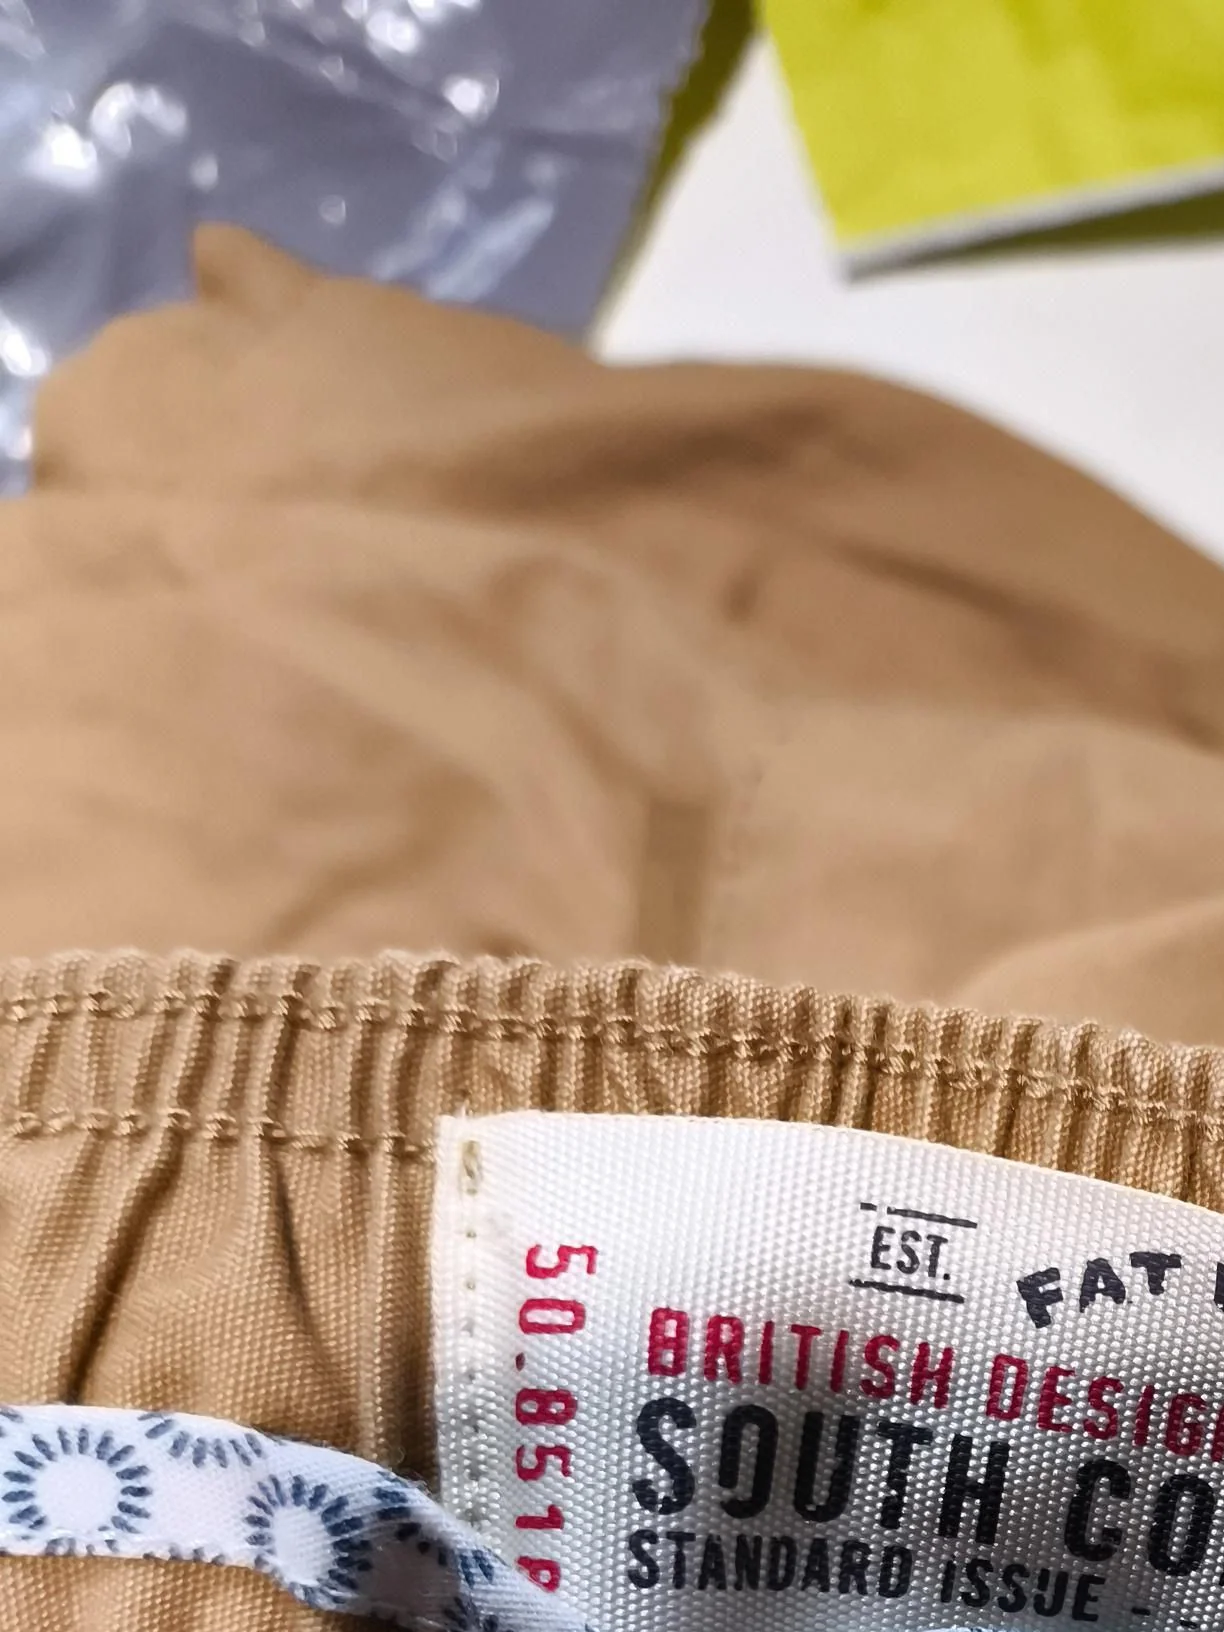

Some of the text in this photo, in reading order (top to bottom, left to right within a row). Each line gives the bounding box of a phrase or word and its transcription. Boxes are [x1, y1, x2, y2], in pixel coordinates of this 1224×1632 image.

[869, 1225, 951, 1282] EST.
[1016, 1251, 1182, 1329] FAT
[647, 1307, 953, 1409] BRITISH
[631, 1397, 1010, 1545] SOUTH
[627, 1530, 912, 1600] STANDARD
[940, 1558, 1106, 1620] ISSUE
